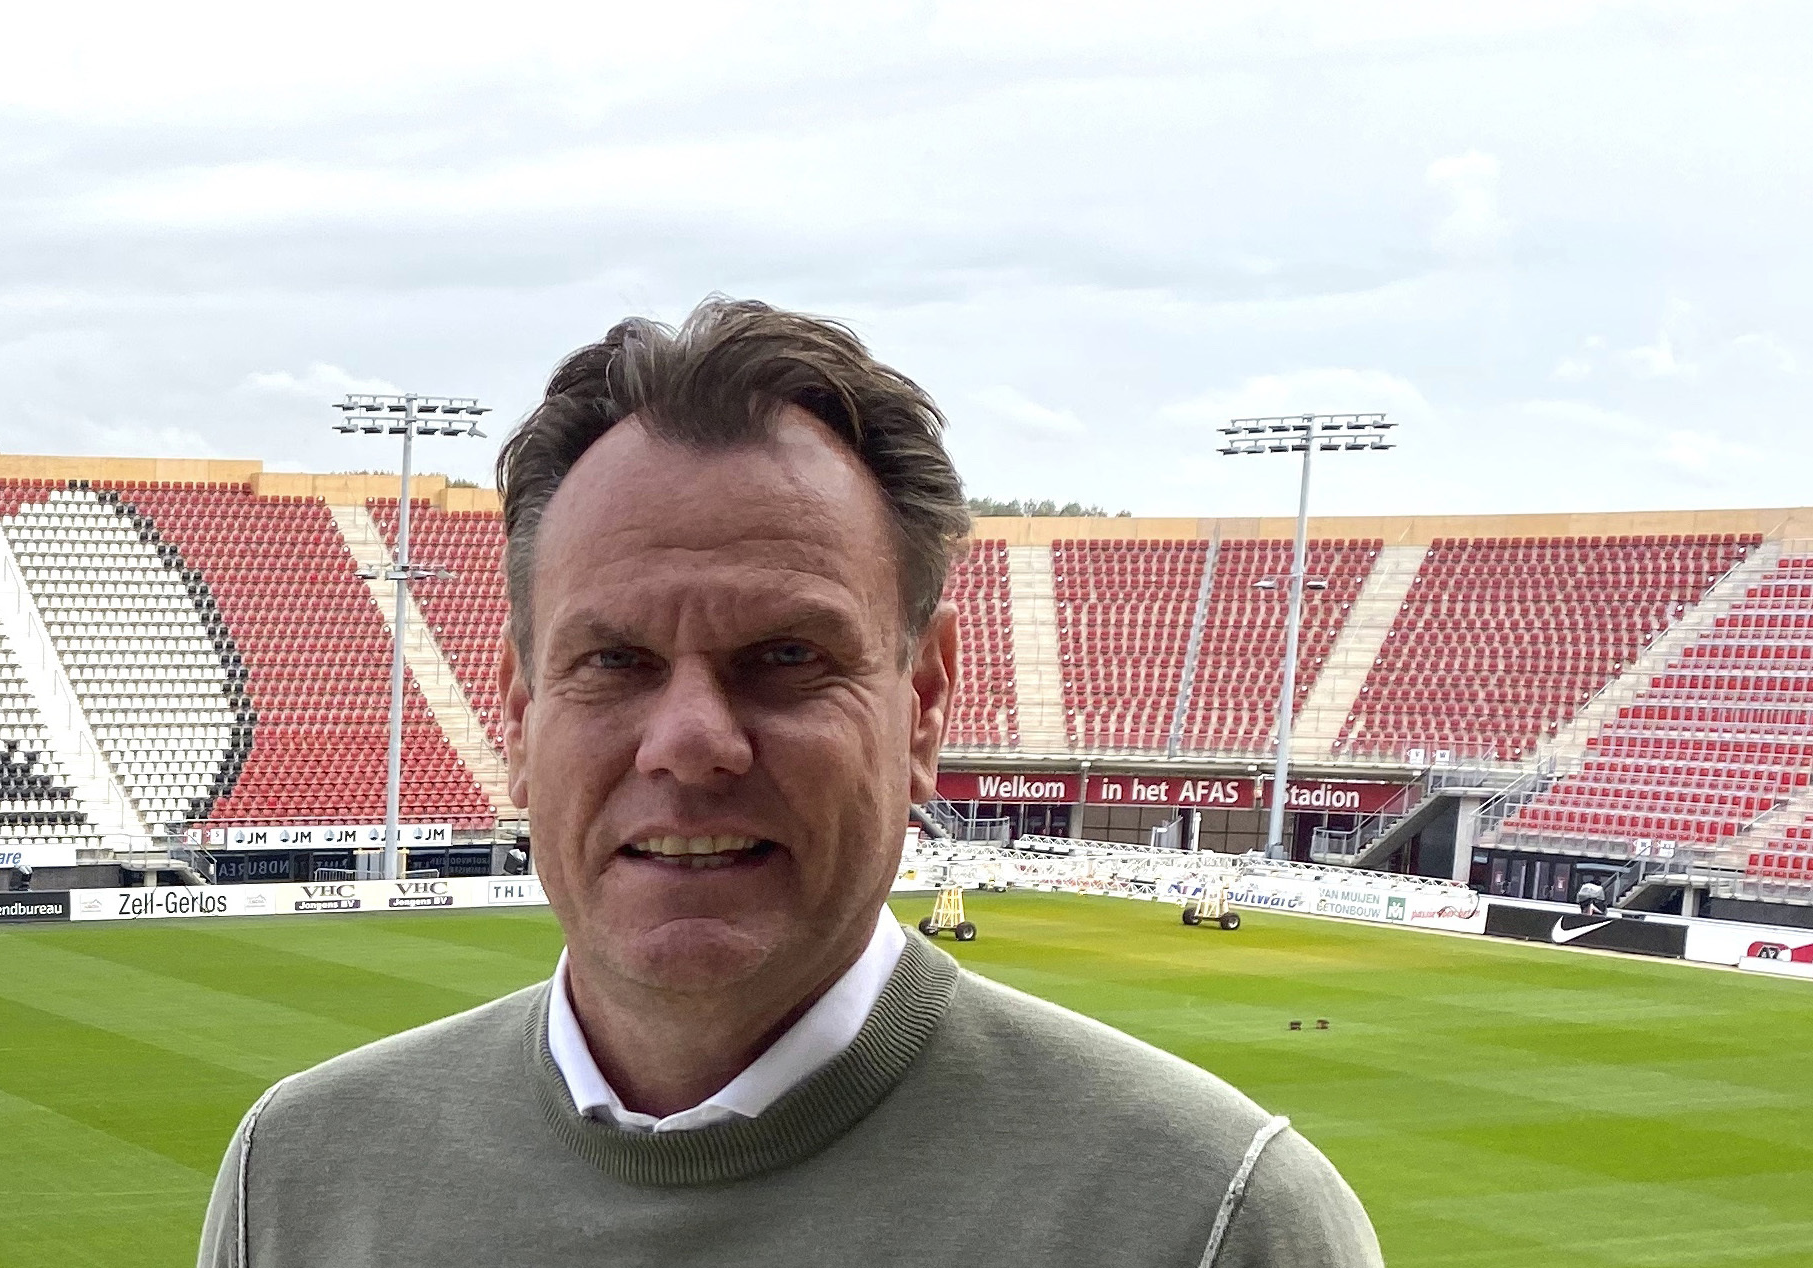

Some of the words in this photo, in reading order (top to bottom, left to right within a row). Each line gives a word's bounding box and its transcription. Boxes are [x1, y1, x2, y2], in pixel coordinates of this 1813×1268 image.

[978, 775, 1066, 798] Welkom
[1101, 777, 1123, 800] in
[1132, 778, 1169, 801] het
[1178, 780, 1239, 804] AFAS
[247, 832, 267, 845] JM
[292, 831, 312, 844] JM
[336, 830, 356, 843] JM
[424, 828, 445, 841] JM
[301, 884, 356, 899] VHC
[395, 881, 448, 896] VHC
[1344, 890, 1380, 905] MUIJEN
